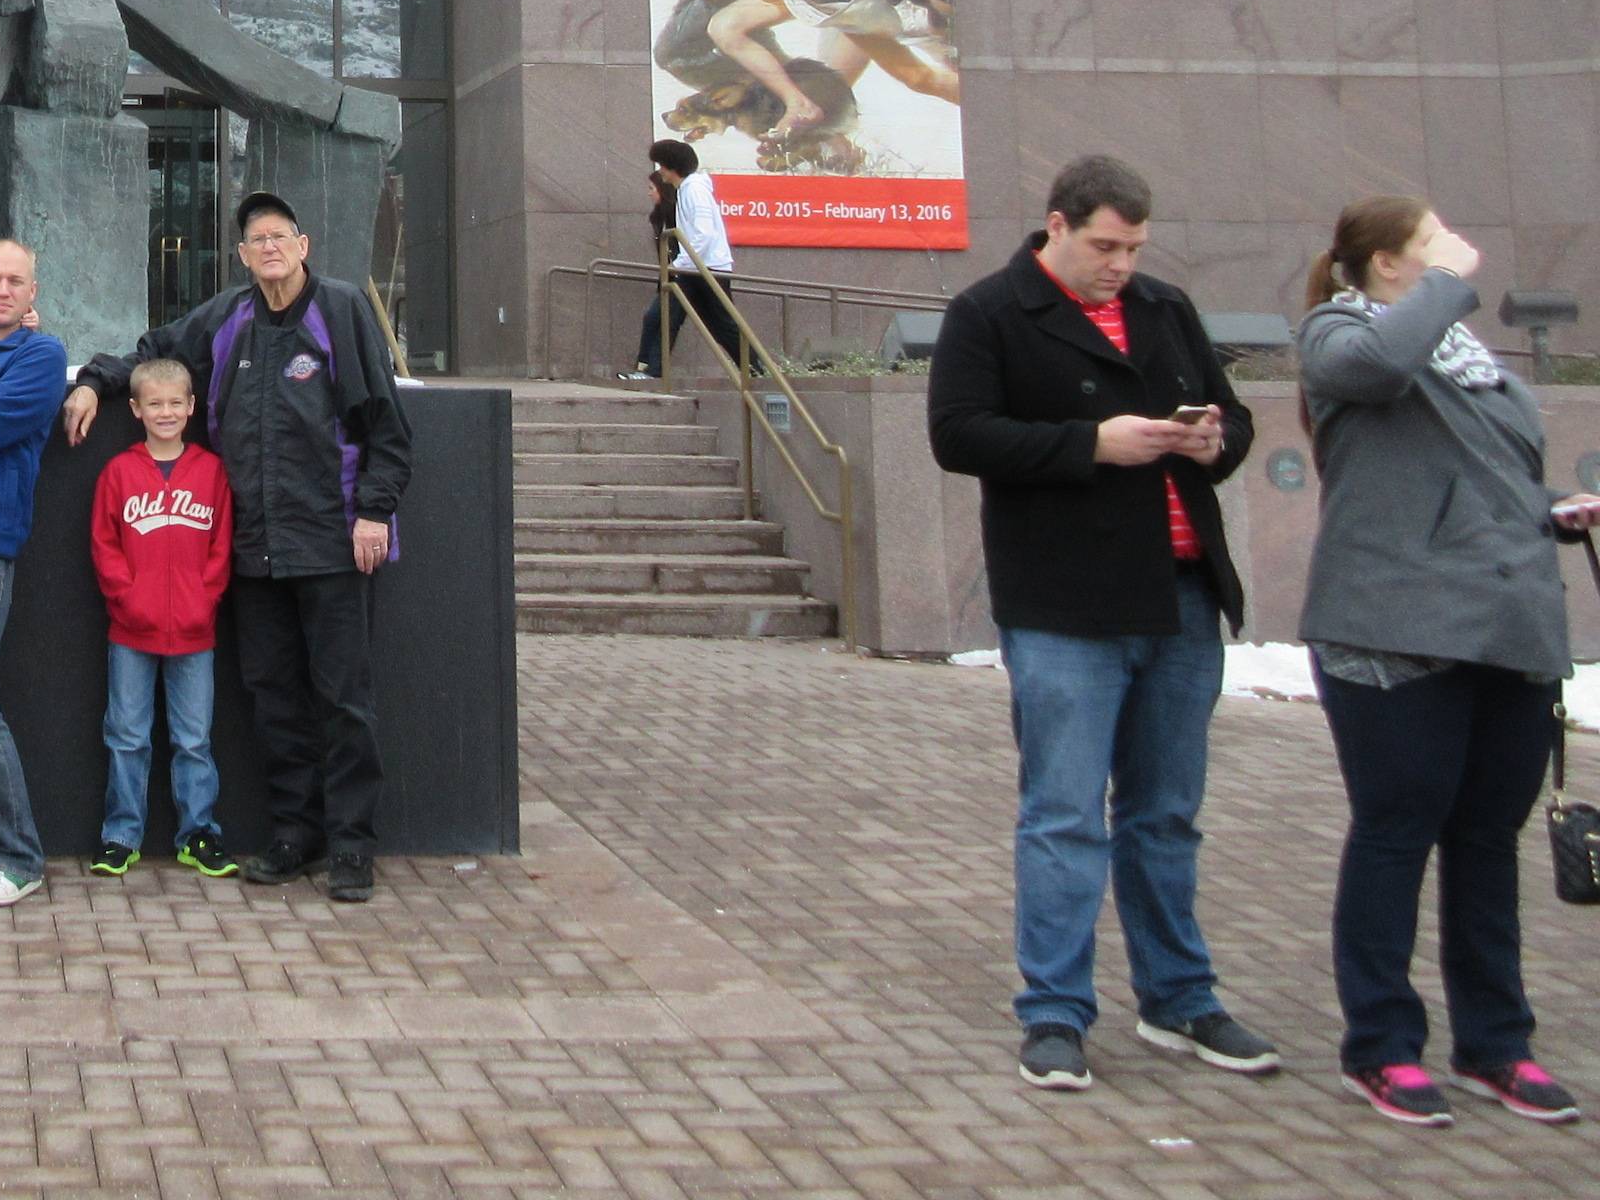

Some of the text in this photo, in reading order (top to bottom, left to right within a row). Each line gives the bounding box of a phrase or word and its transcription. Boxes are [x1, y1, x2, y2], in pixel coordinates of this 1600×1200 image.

[747, 200, 771, 219] 20,
[889, 203, 912, 222] 13,
[915, 204, 952, 221] 2016
[122, 490, 166, 524] Old
